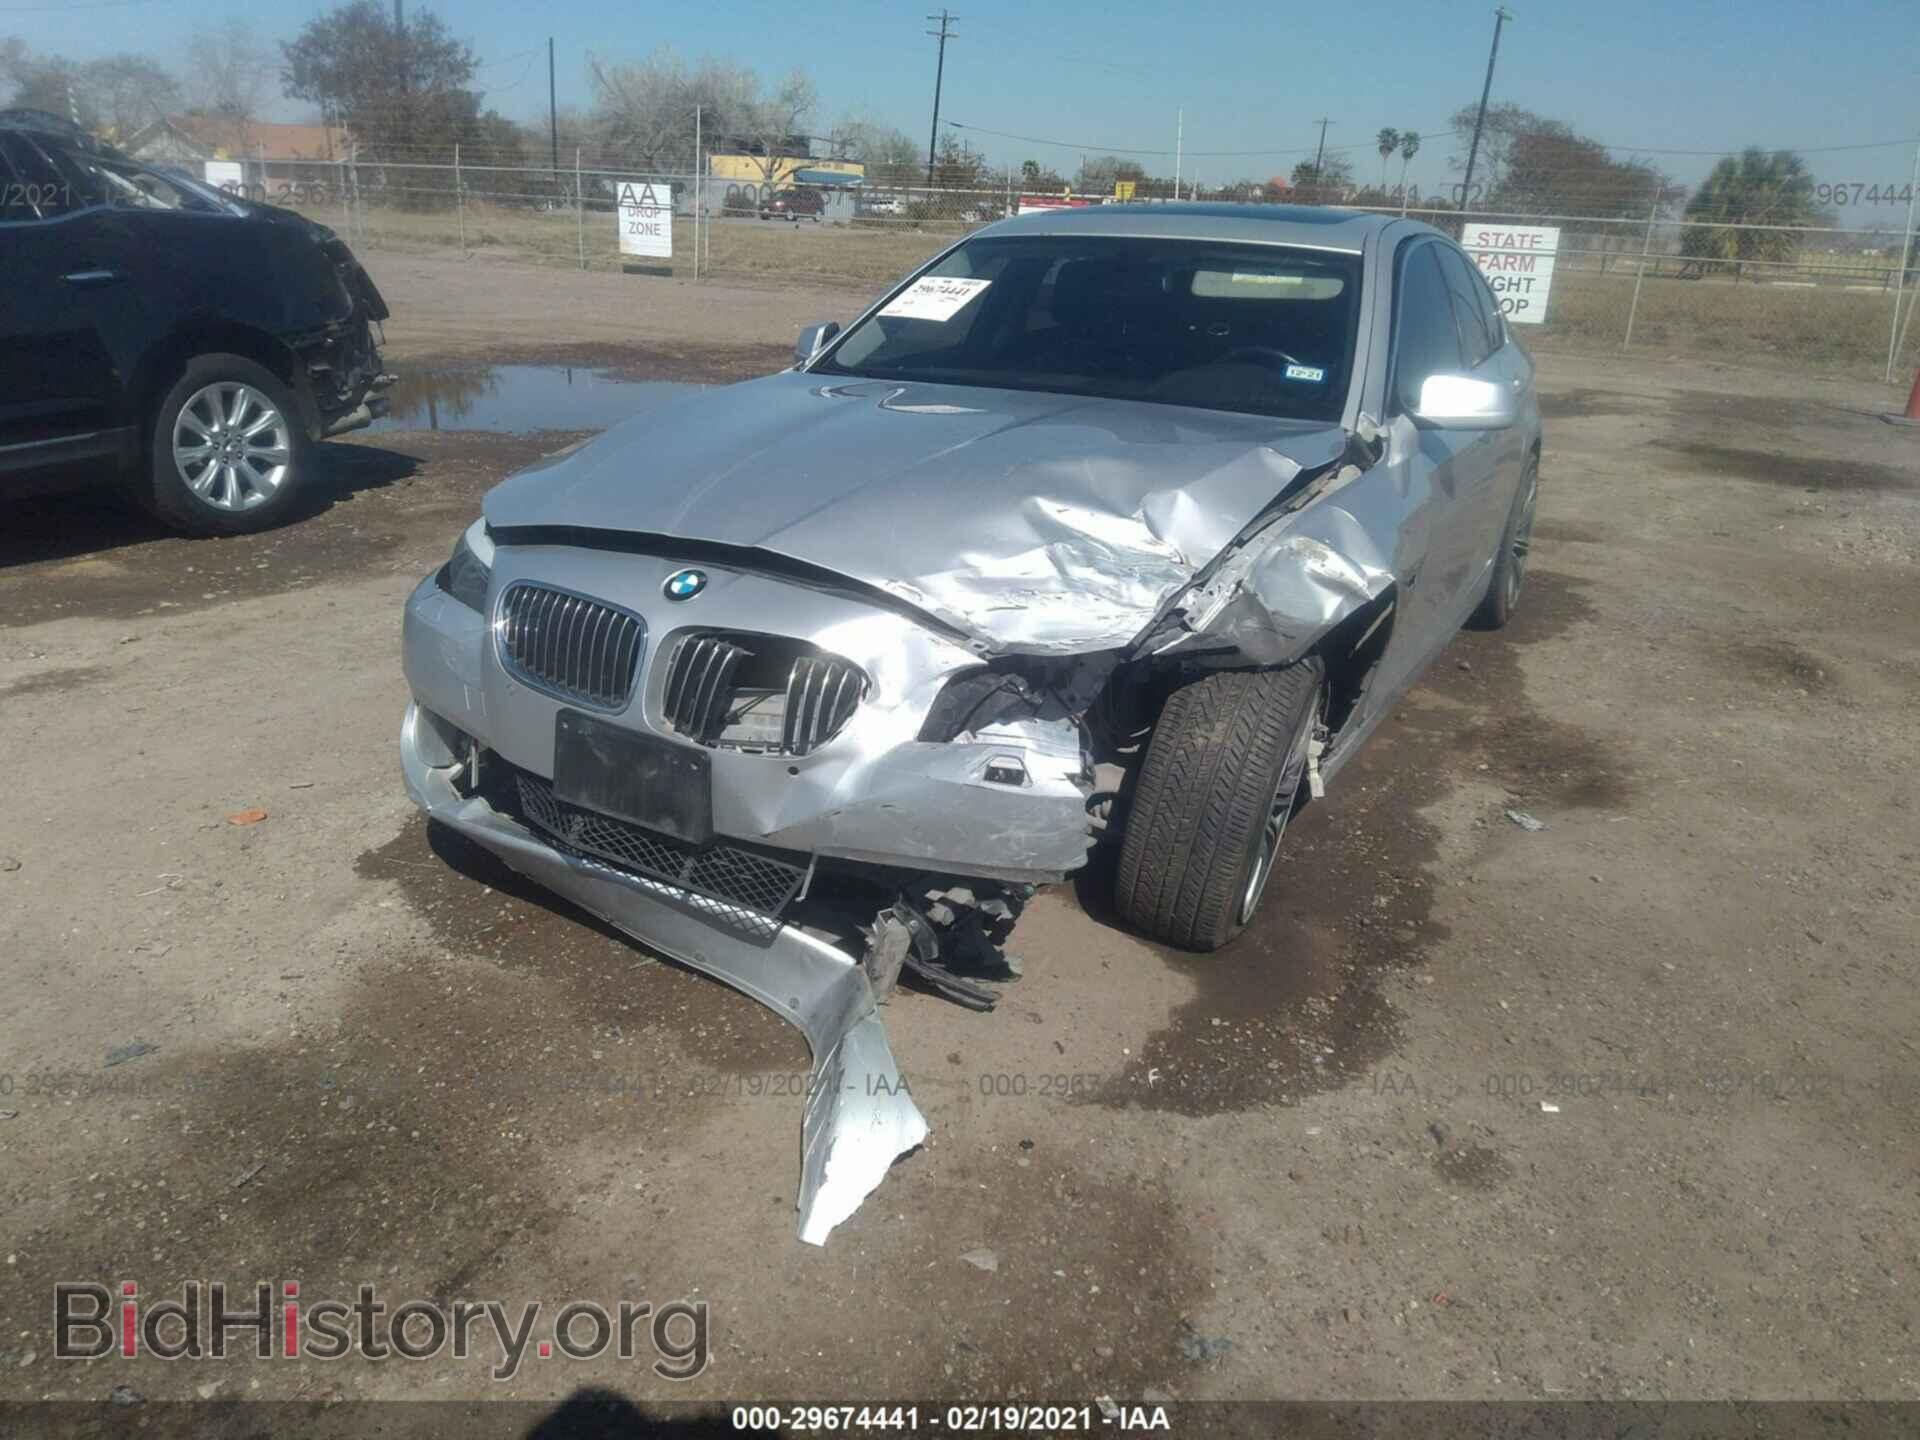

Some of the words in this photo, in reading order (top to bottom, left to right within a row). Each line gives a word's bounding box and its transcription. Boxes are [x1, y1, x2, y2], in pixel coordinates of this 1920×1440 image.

[627, 205, 661, 219] DROP
[628, 221, 662, 236] ZONE
[1476, 231, 1543, 249] STATE
[1477, 251, 1537, 273] FARM
[1486, 274, 1537, 293] GHT
[1499, 297, 1529, 315] OP
